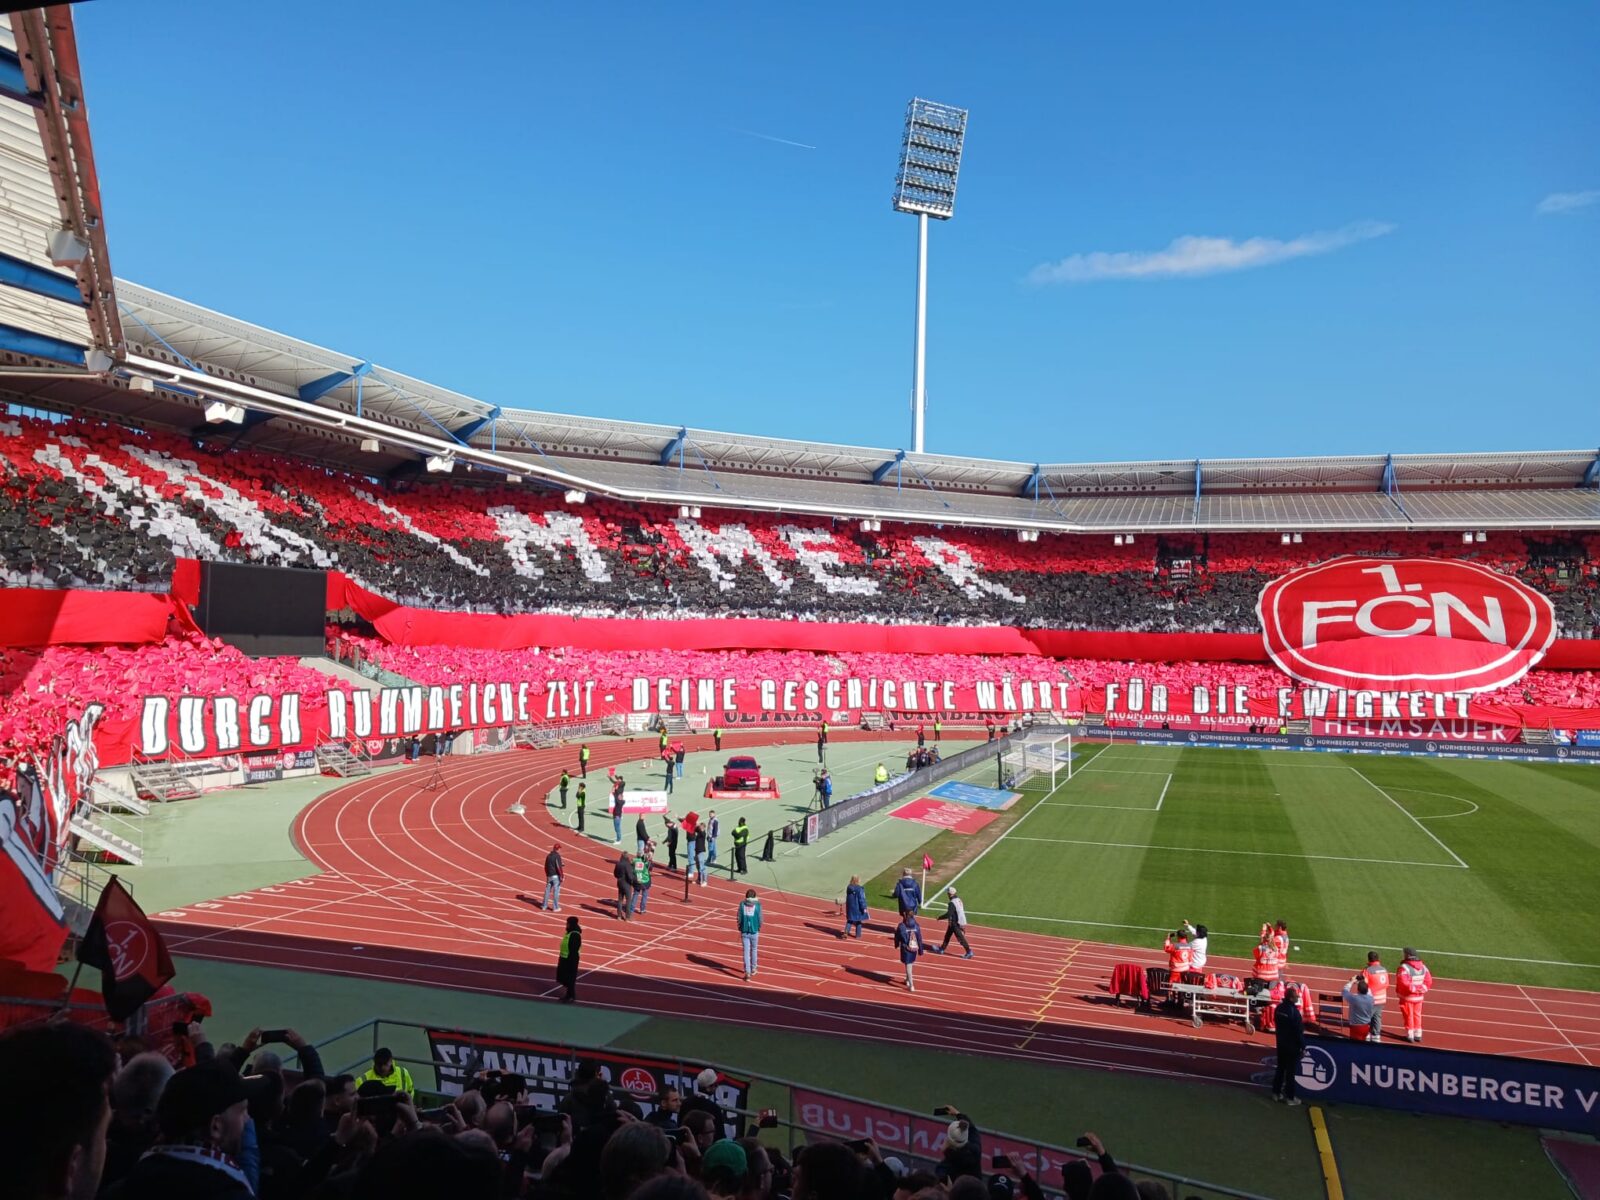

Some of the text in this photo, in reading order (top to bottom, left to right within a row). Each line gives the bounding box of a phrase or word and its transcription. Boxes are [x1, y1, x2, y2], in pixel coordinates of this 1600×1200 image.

[1361, 564, 1422, 593] 1.
[1302, 591, 1507, 649] FCN
[141, 693, 302, 756] DURCH
[328, 682, 529, 738] RUHMREICHE
[546, 680, 595, 719] ZEIT
[632, 677, 738, 712] DEINE
[761, 678, 956, 711] GESCHICHTE
[975, 675, 1069, 711] WÄHRT
[1106, 677, 1168, 714] FÜR
[1192, 685, 1250, 715] DIE
[1278, 687, 1473, 718] EWIGKEIT
[1325, 718, 1507, 741] HELMSAUER
[1439, 744, 1485, 752] NÜRNBERGER
[1486, 746, 1539, 754] VERSICHERUNG
[1351, 1062, 1599, 1113] NÜRNBERGER V
